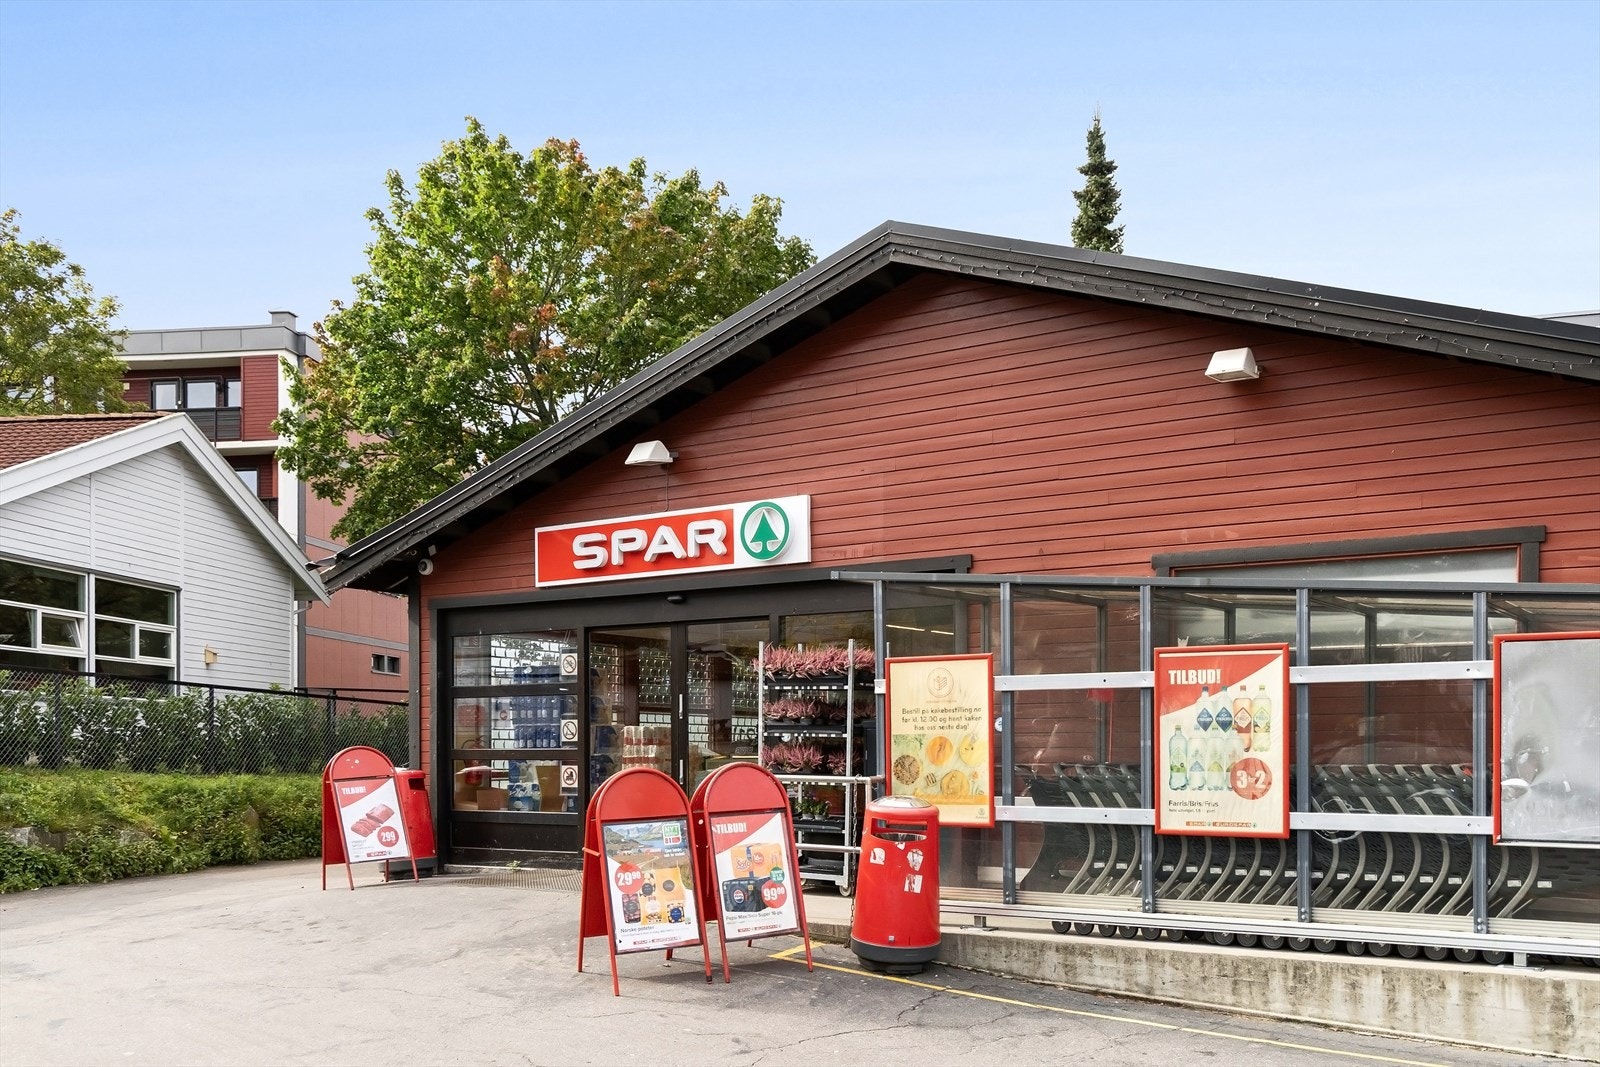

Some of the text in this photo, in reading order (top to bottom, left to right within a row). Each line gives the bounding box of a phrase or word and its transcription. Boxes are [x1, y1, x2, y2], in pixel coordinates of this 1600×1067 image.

[572, 519, 727, 570] SPAR
[1168, 669, 1221, 685] TILBUD!
[902, 707, 921, 715] Bestill
[930, 706, 982, 714] kakebestilling.no
[955, 723, 970, 731] dag!
[1236, 770, 1248, 789] 3
[1255, 770, 1266, 789] 2
[341, 786, 366, 796] TILBUD!
[716, 822, 747, 834] TILBUD!
[381, 831, 396, 842] 299
